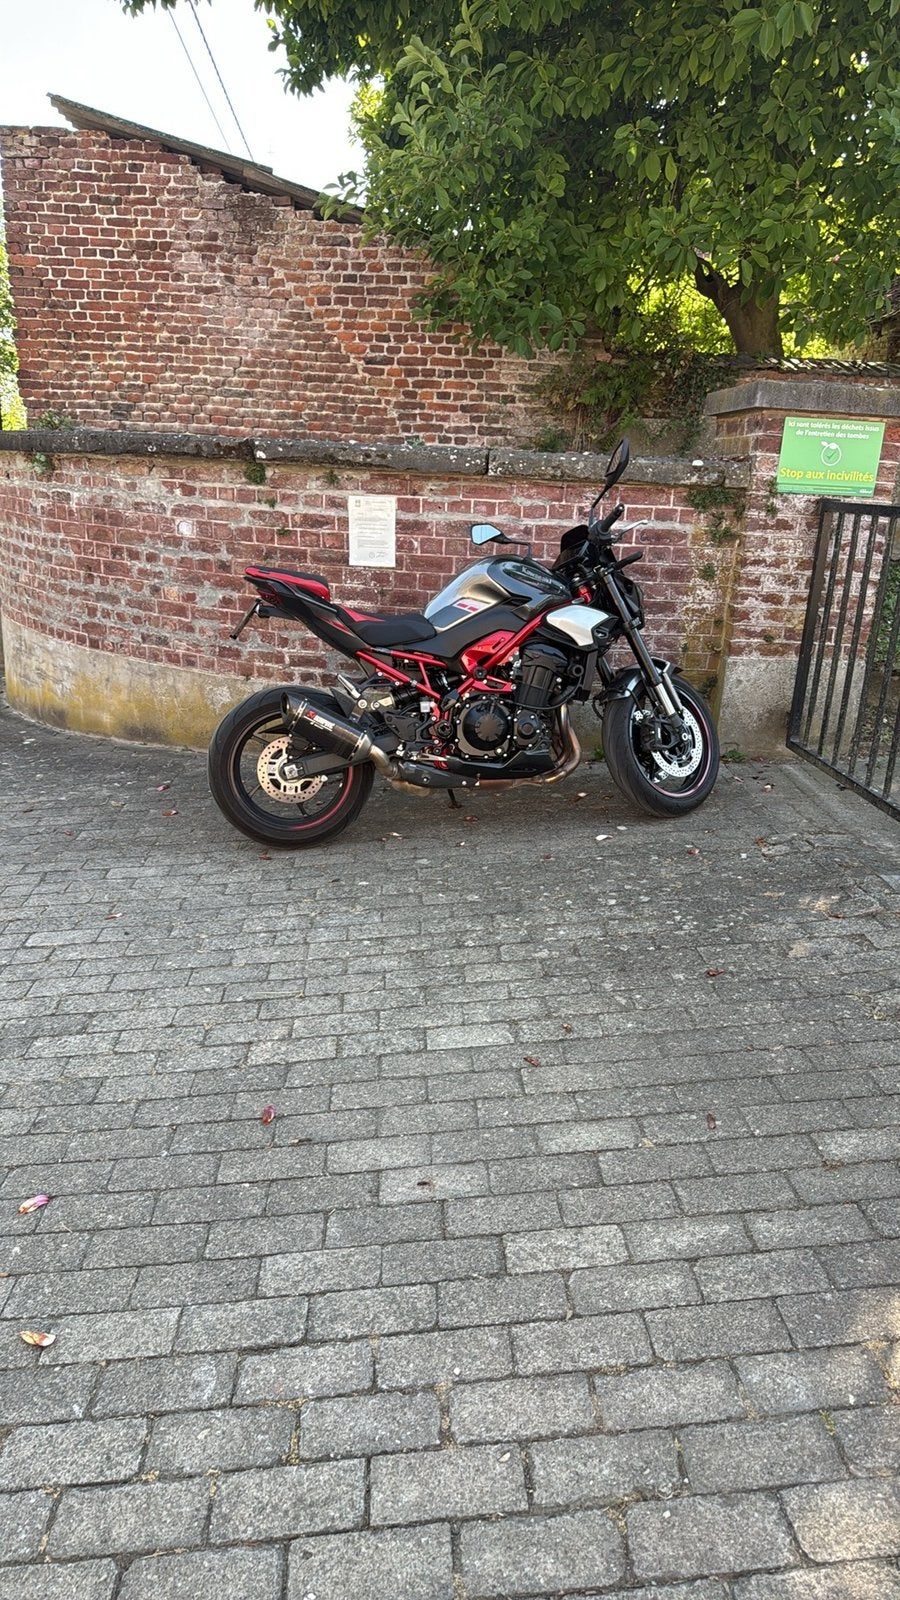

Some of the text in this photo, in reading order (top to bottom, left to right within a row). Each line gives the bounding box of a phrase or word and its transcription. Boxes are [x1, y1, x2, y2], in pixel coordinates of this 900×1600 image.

[780, 467, 874, 482] Stop aux incivilités
